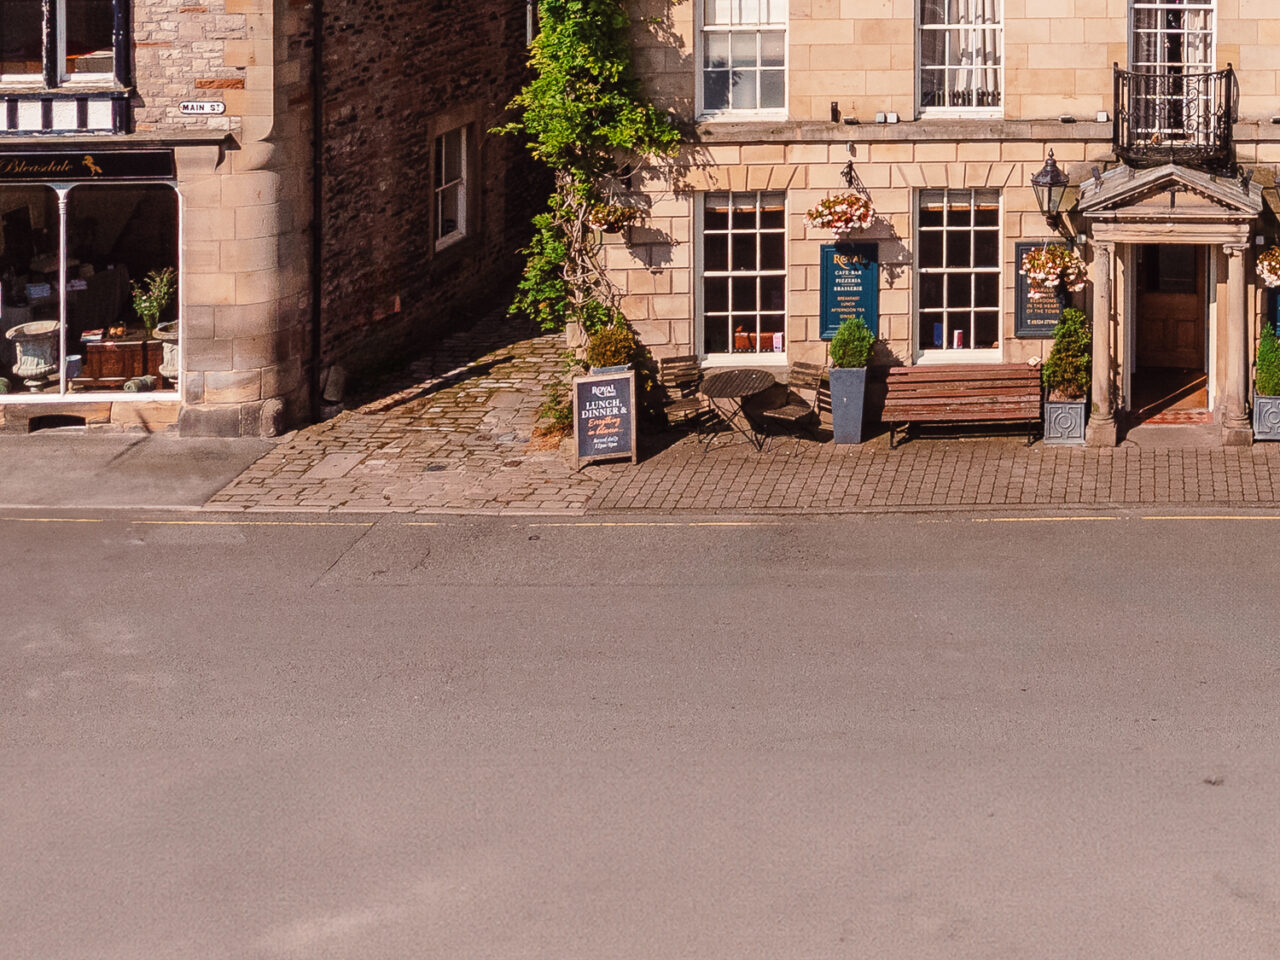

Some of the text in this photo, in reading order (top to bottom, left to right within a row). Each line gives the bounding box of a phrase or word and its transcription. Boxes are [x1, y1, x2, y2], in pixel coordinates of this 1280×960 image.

[592, 384, 615, 397] ROYAL
[586, 399, 622, 410] LUNCH,
[582, 408, 619, 418] DINNER
